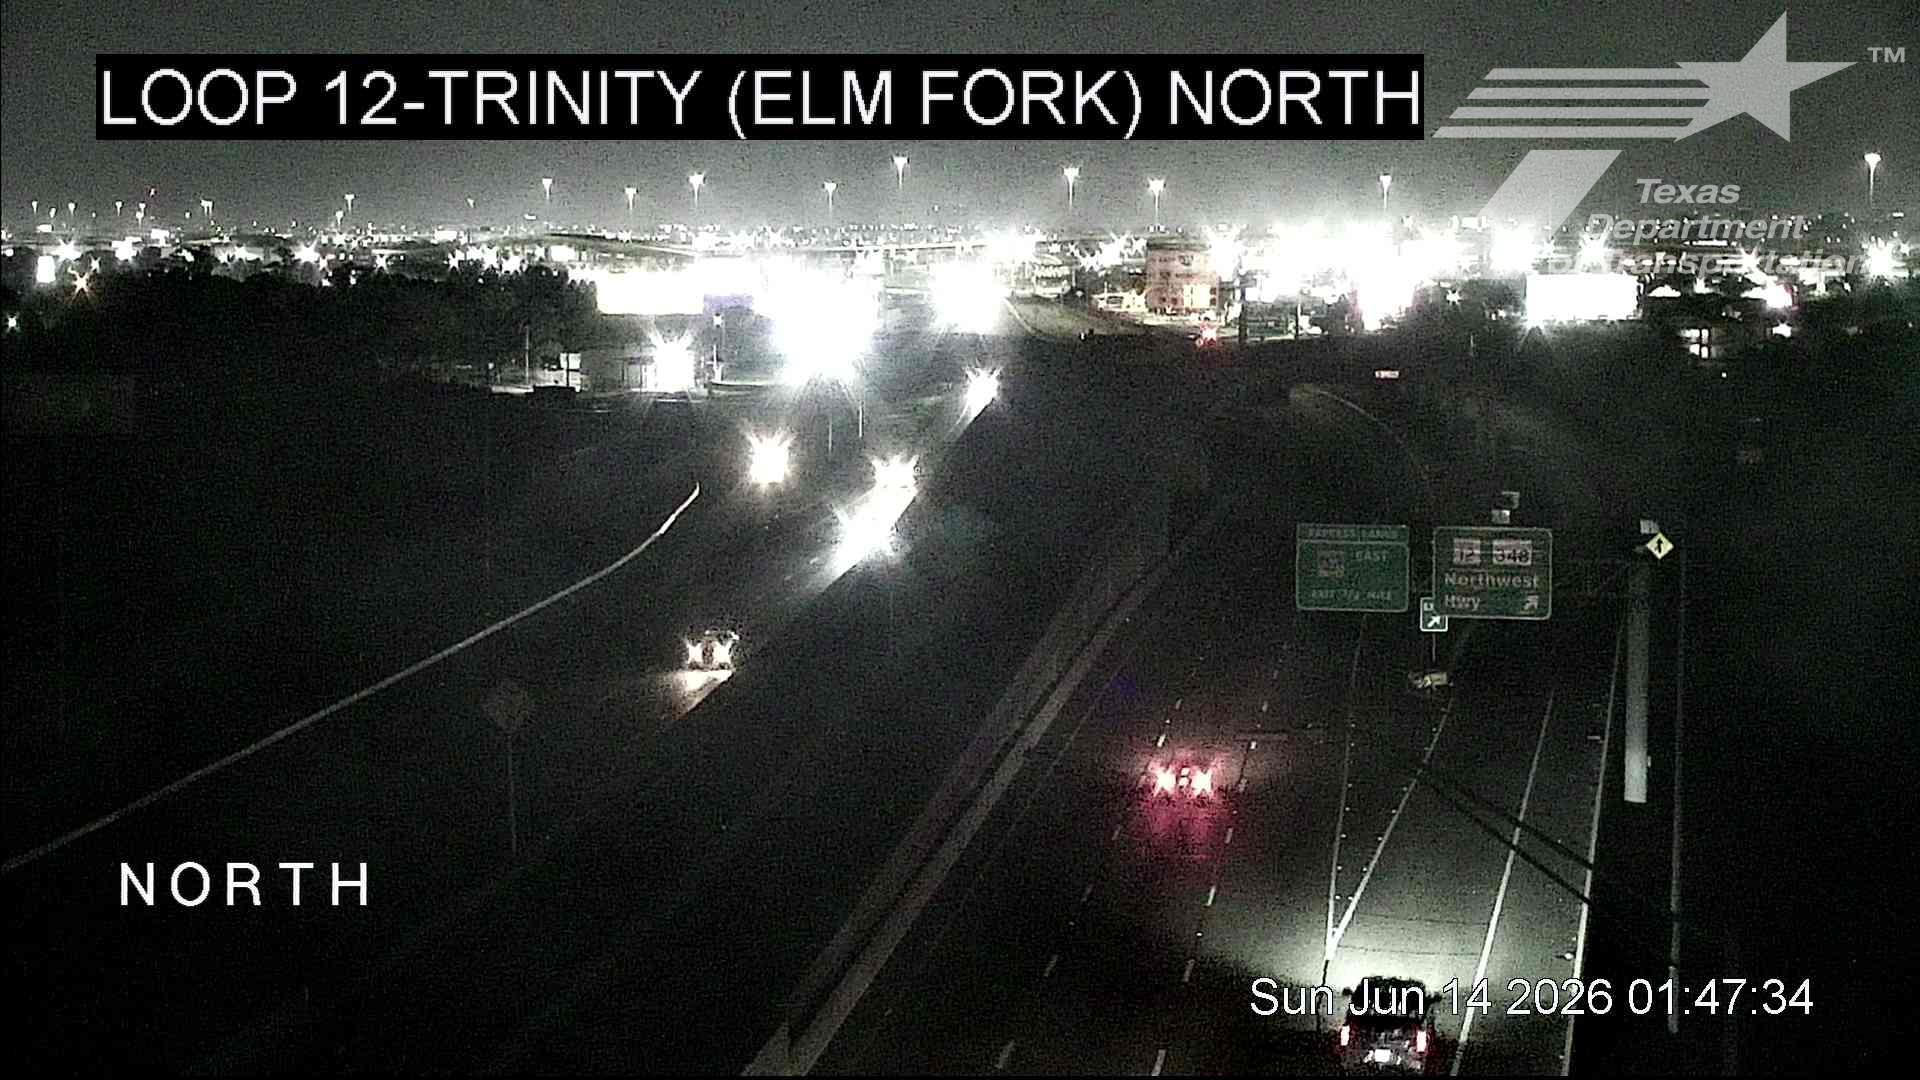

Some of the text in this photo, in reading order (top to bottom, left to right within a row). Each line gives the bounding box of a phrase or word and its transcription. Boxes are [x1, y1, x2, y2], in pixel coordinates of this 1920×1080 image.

[1494, 547, 1530, 563] 348
[1444, 571, 1540, 588] Northwest
[1444, 594, 1481, 612] Hwy
